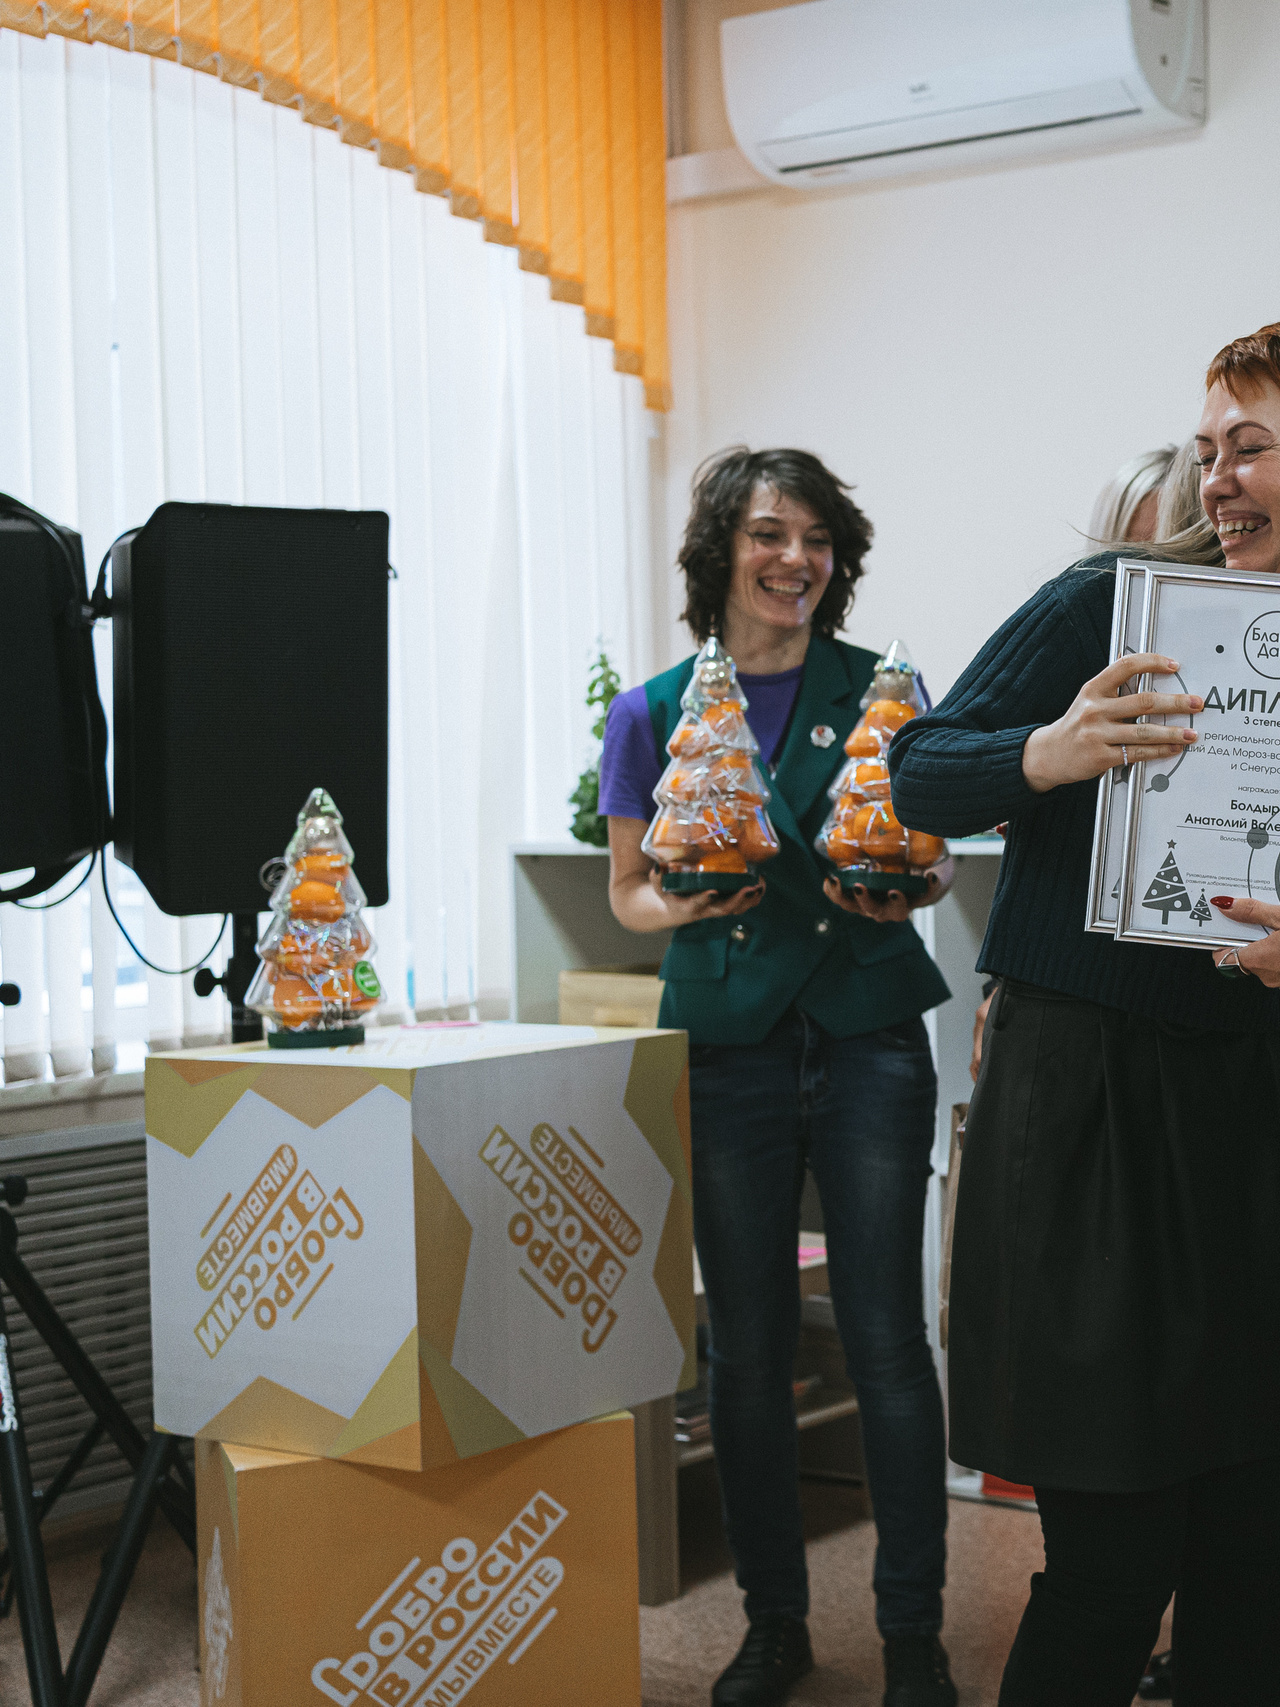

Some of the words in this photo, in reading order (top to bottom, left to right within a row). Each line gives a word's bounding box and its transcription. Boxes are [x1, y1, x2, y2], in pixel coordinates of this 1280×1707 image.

[1183, 744, 1206, 754] ший
[1207, 745, 1230, 757] Дед
[1204, 732, 1280, 746] регионального
[1244, 716, 1250, 725] 3
[1185, 813, 1247, 829] Анатолий
[200, 1146, 295, 1286] #МЫВМЕСТЕ
[296, 1173, 323, 1213] В
[482, 1131, 602, 1270] РОССИИ
[535, 1127, 642, 1252] #МЫВМЕСТЕ
[198, 1204, 303, 1355] РОССИИ
[597, 1259, 623, 1295] В
[372, 1671, 411, 1707] В
[404, 1496, 561, 1671] РОССИИ
[424, 1564, 558, 1707] МЫВМЕСТЕ
